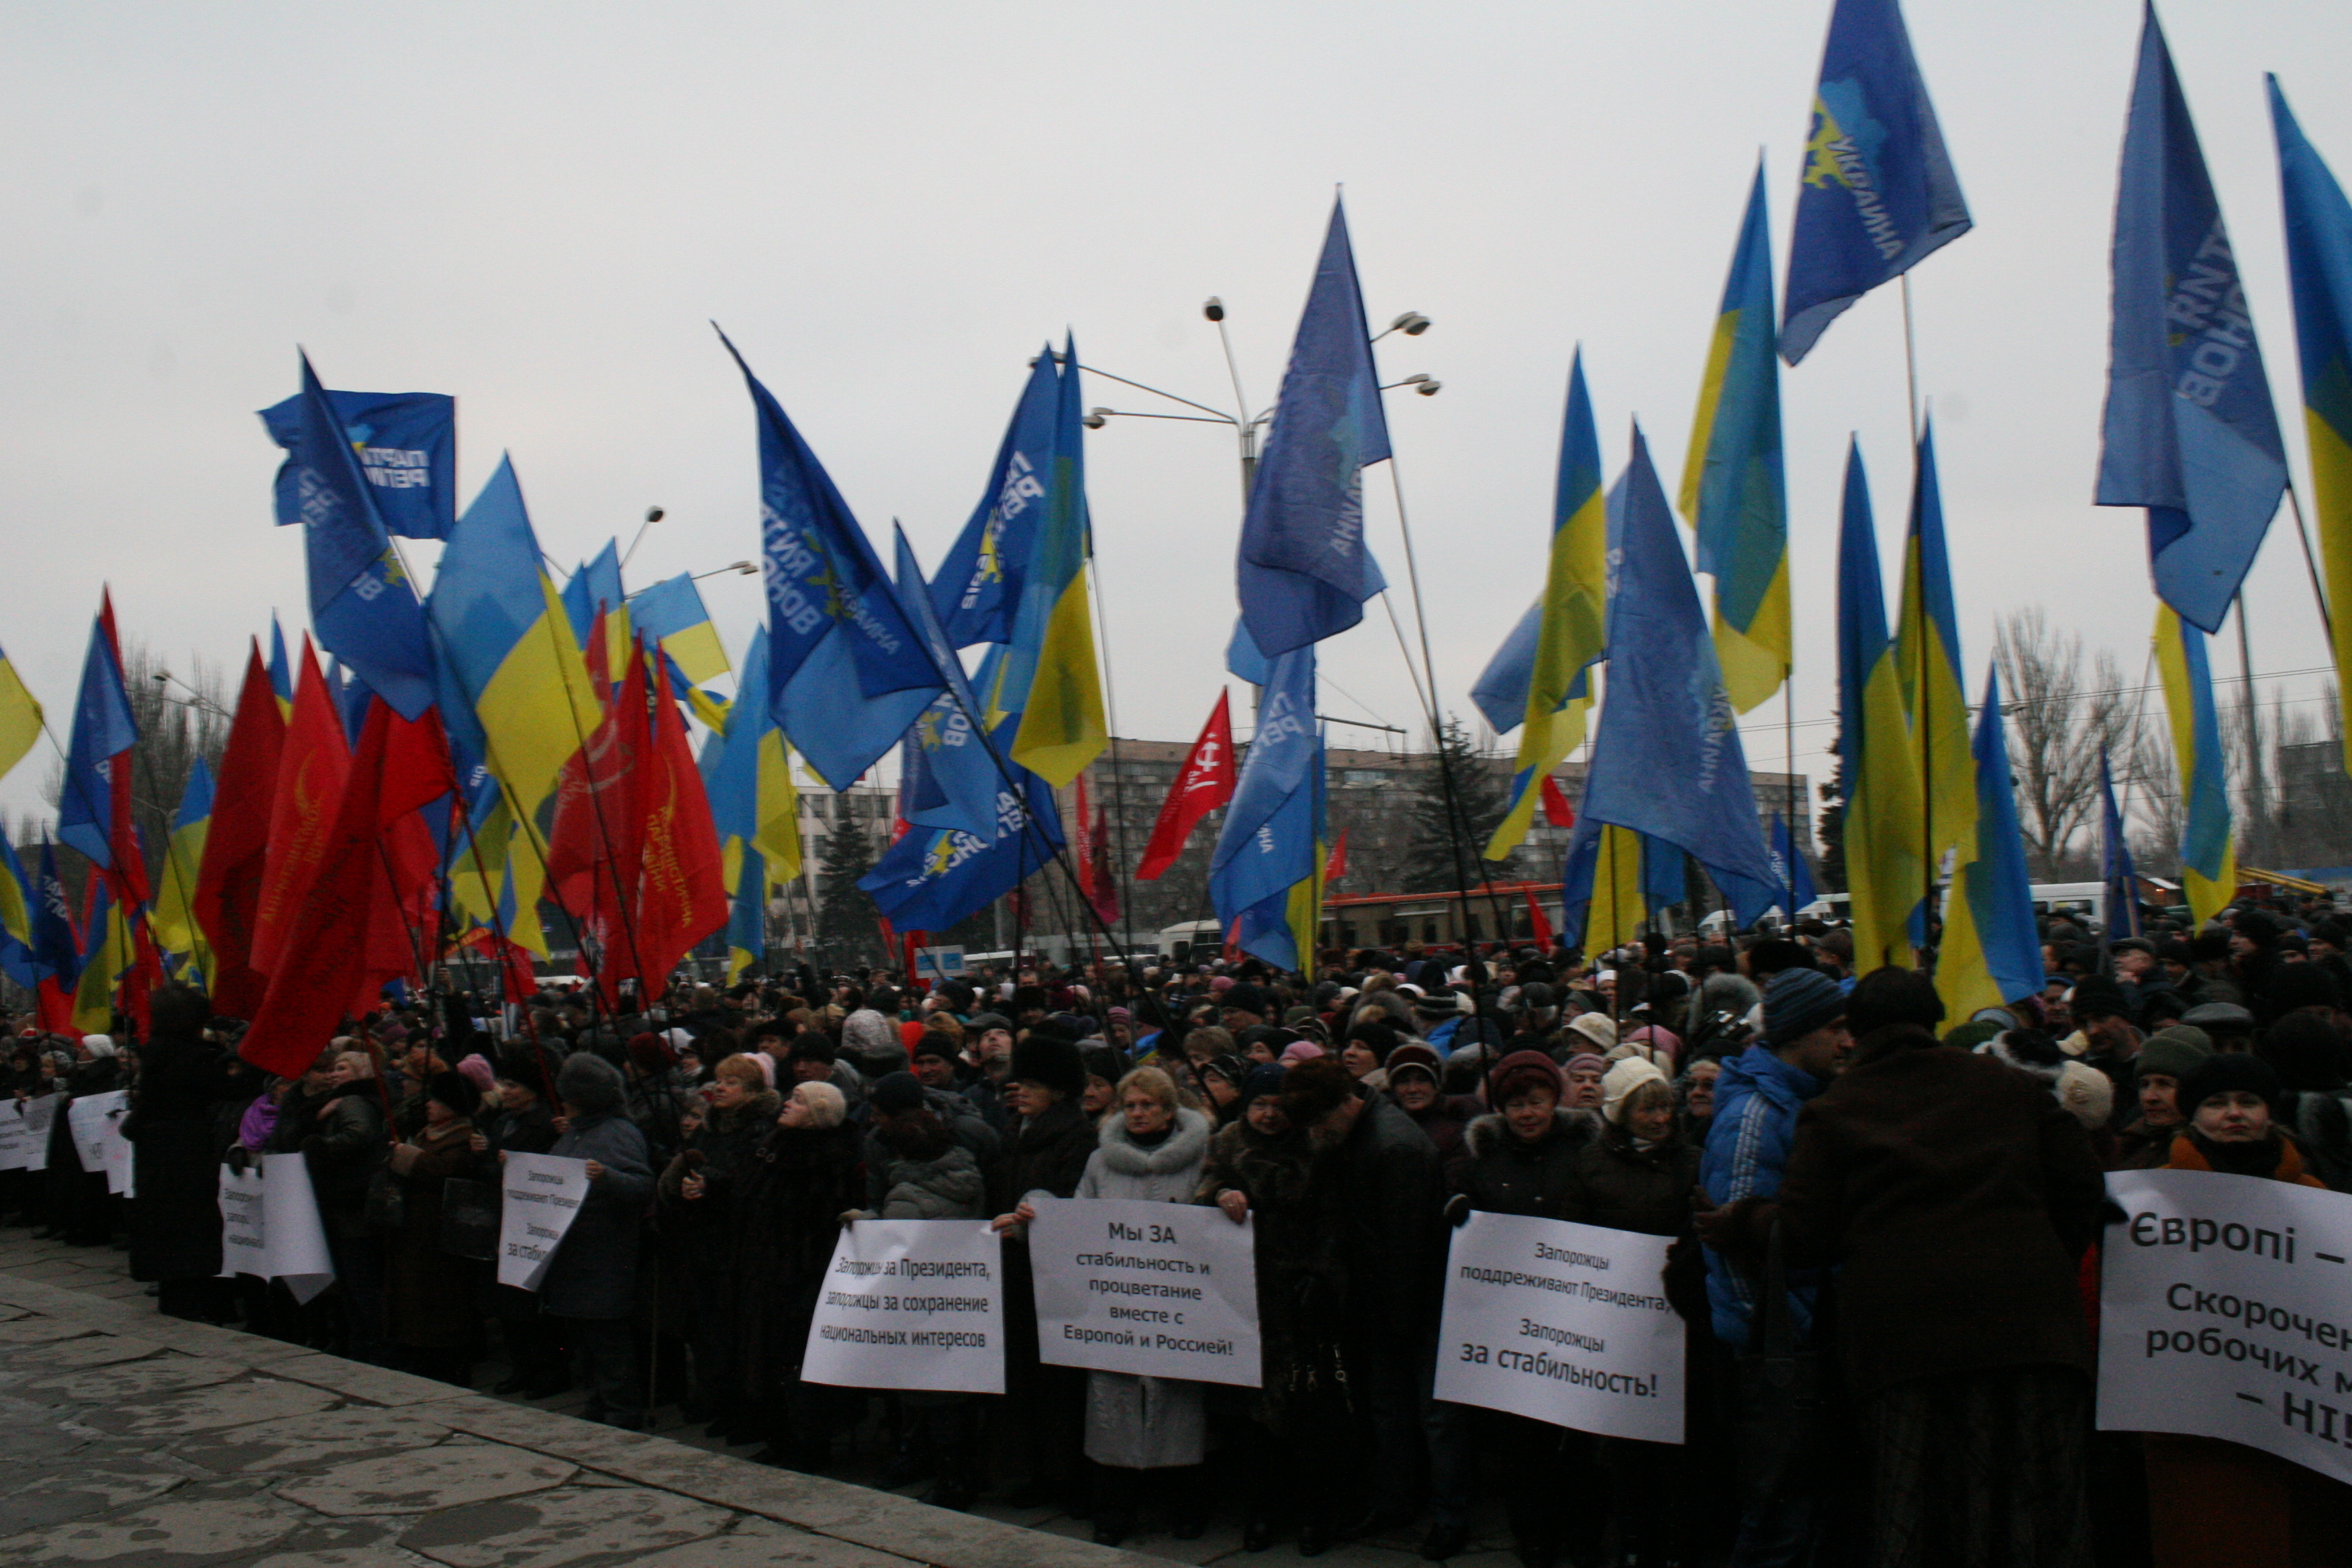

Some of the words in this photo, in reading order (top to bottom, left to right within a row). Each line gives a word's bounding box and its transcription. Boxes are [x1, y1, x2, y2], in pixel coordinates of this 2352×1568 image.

[1826, 136, 1906, 260] УКРАИНА
[1108, 1222, 1142, 1242] Мы
[1149, 1225, 1177, 1244] ЗА
[2129, 1211, 2296, 1265] Європі
[883, 1261, 896, 1275] за
[900, 1258, 990, 1281] Президента,
[1076, 1252, 1195, 1273] стабильность
[1199, 1263, 1210, 1275] и
[1534, 1242, 1609, 1271] Запорожцы
[1089, 1279, 1202, 1300] процветание
[1460, 1265, 1579, 1297] поддреживают
[826, 1291, 879, 1311] запорожцы
[883, 1295, 898, 1311] за
[903, 1295, 988, 1315] сохранение
[1110, 1306, 1169, 1324] вместе
[1174, 1312, 1184, 1325] с
[820, 1324, 906, 1346] национальных
[912, 1330, 986, 1350] интересов
[1063, 1324, 1134, 1346] Европой
[1140, 1334, 1150, 1348] и
[1155, 1334, 1234, 1356] Россией!
[1518, 1318, 1605, 1354] Запорожцы
[1459, 1342, 1489, 1365] за
[1497, 1351, 1658, 1398] стабильность!
[2146, 1326, 2320, 1387] робочих
